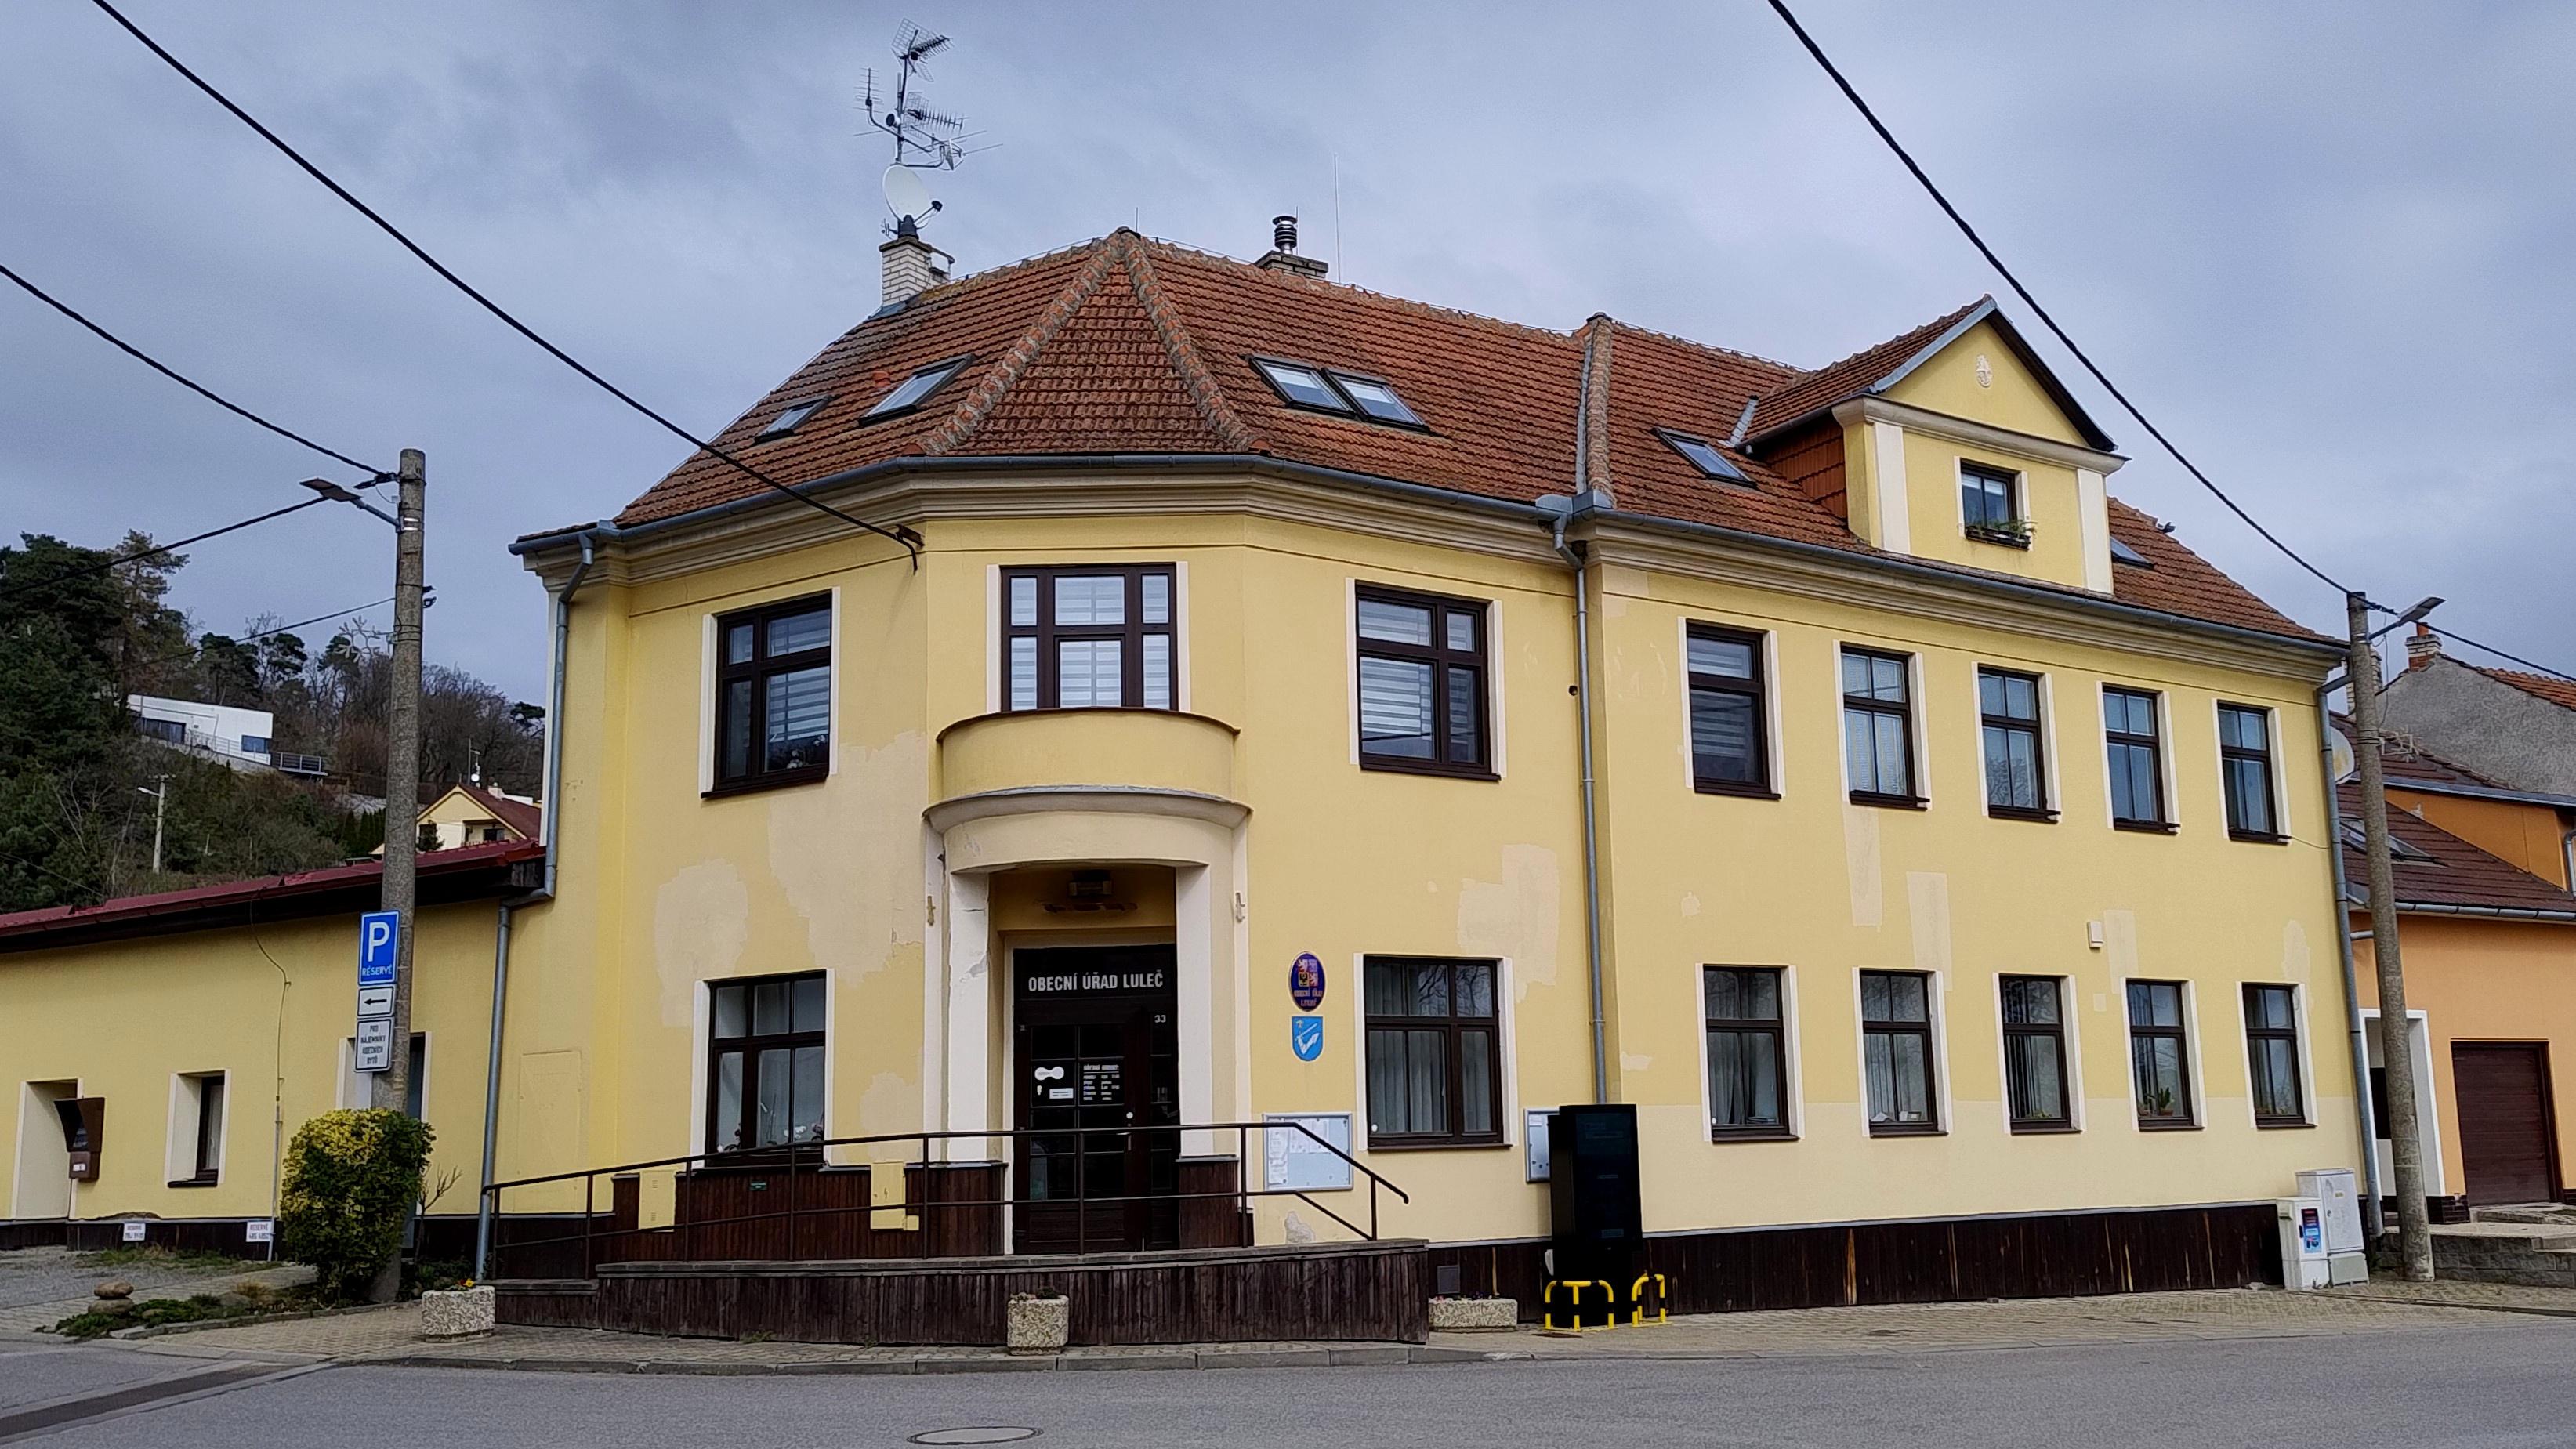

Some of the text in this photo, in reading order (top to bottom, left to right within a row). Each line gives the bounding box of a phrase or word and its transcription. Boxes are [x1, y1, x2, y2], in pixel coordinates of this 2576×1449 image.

[368, 921, 390, 962] P
[1028, 969, 1164, 991] OBECNÍ ÚŘAD LULEČ
[1154, 1014, 1167, 1023] 33
